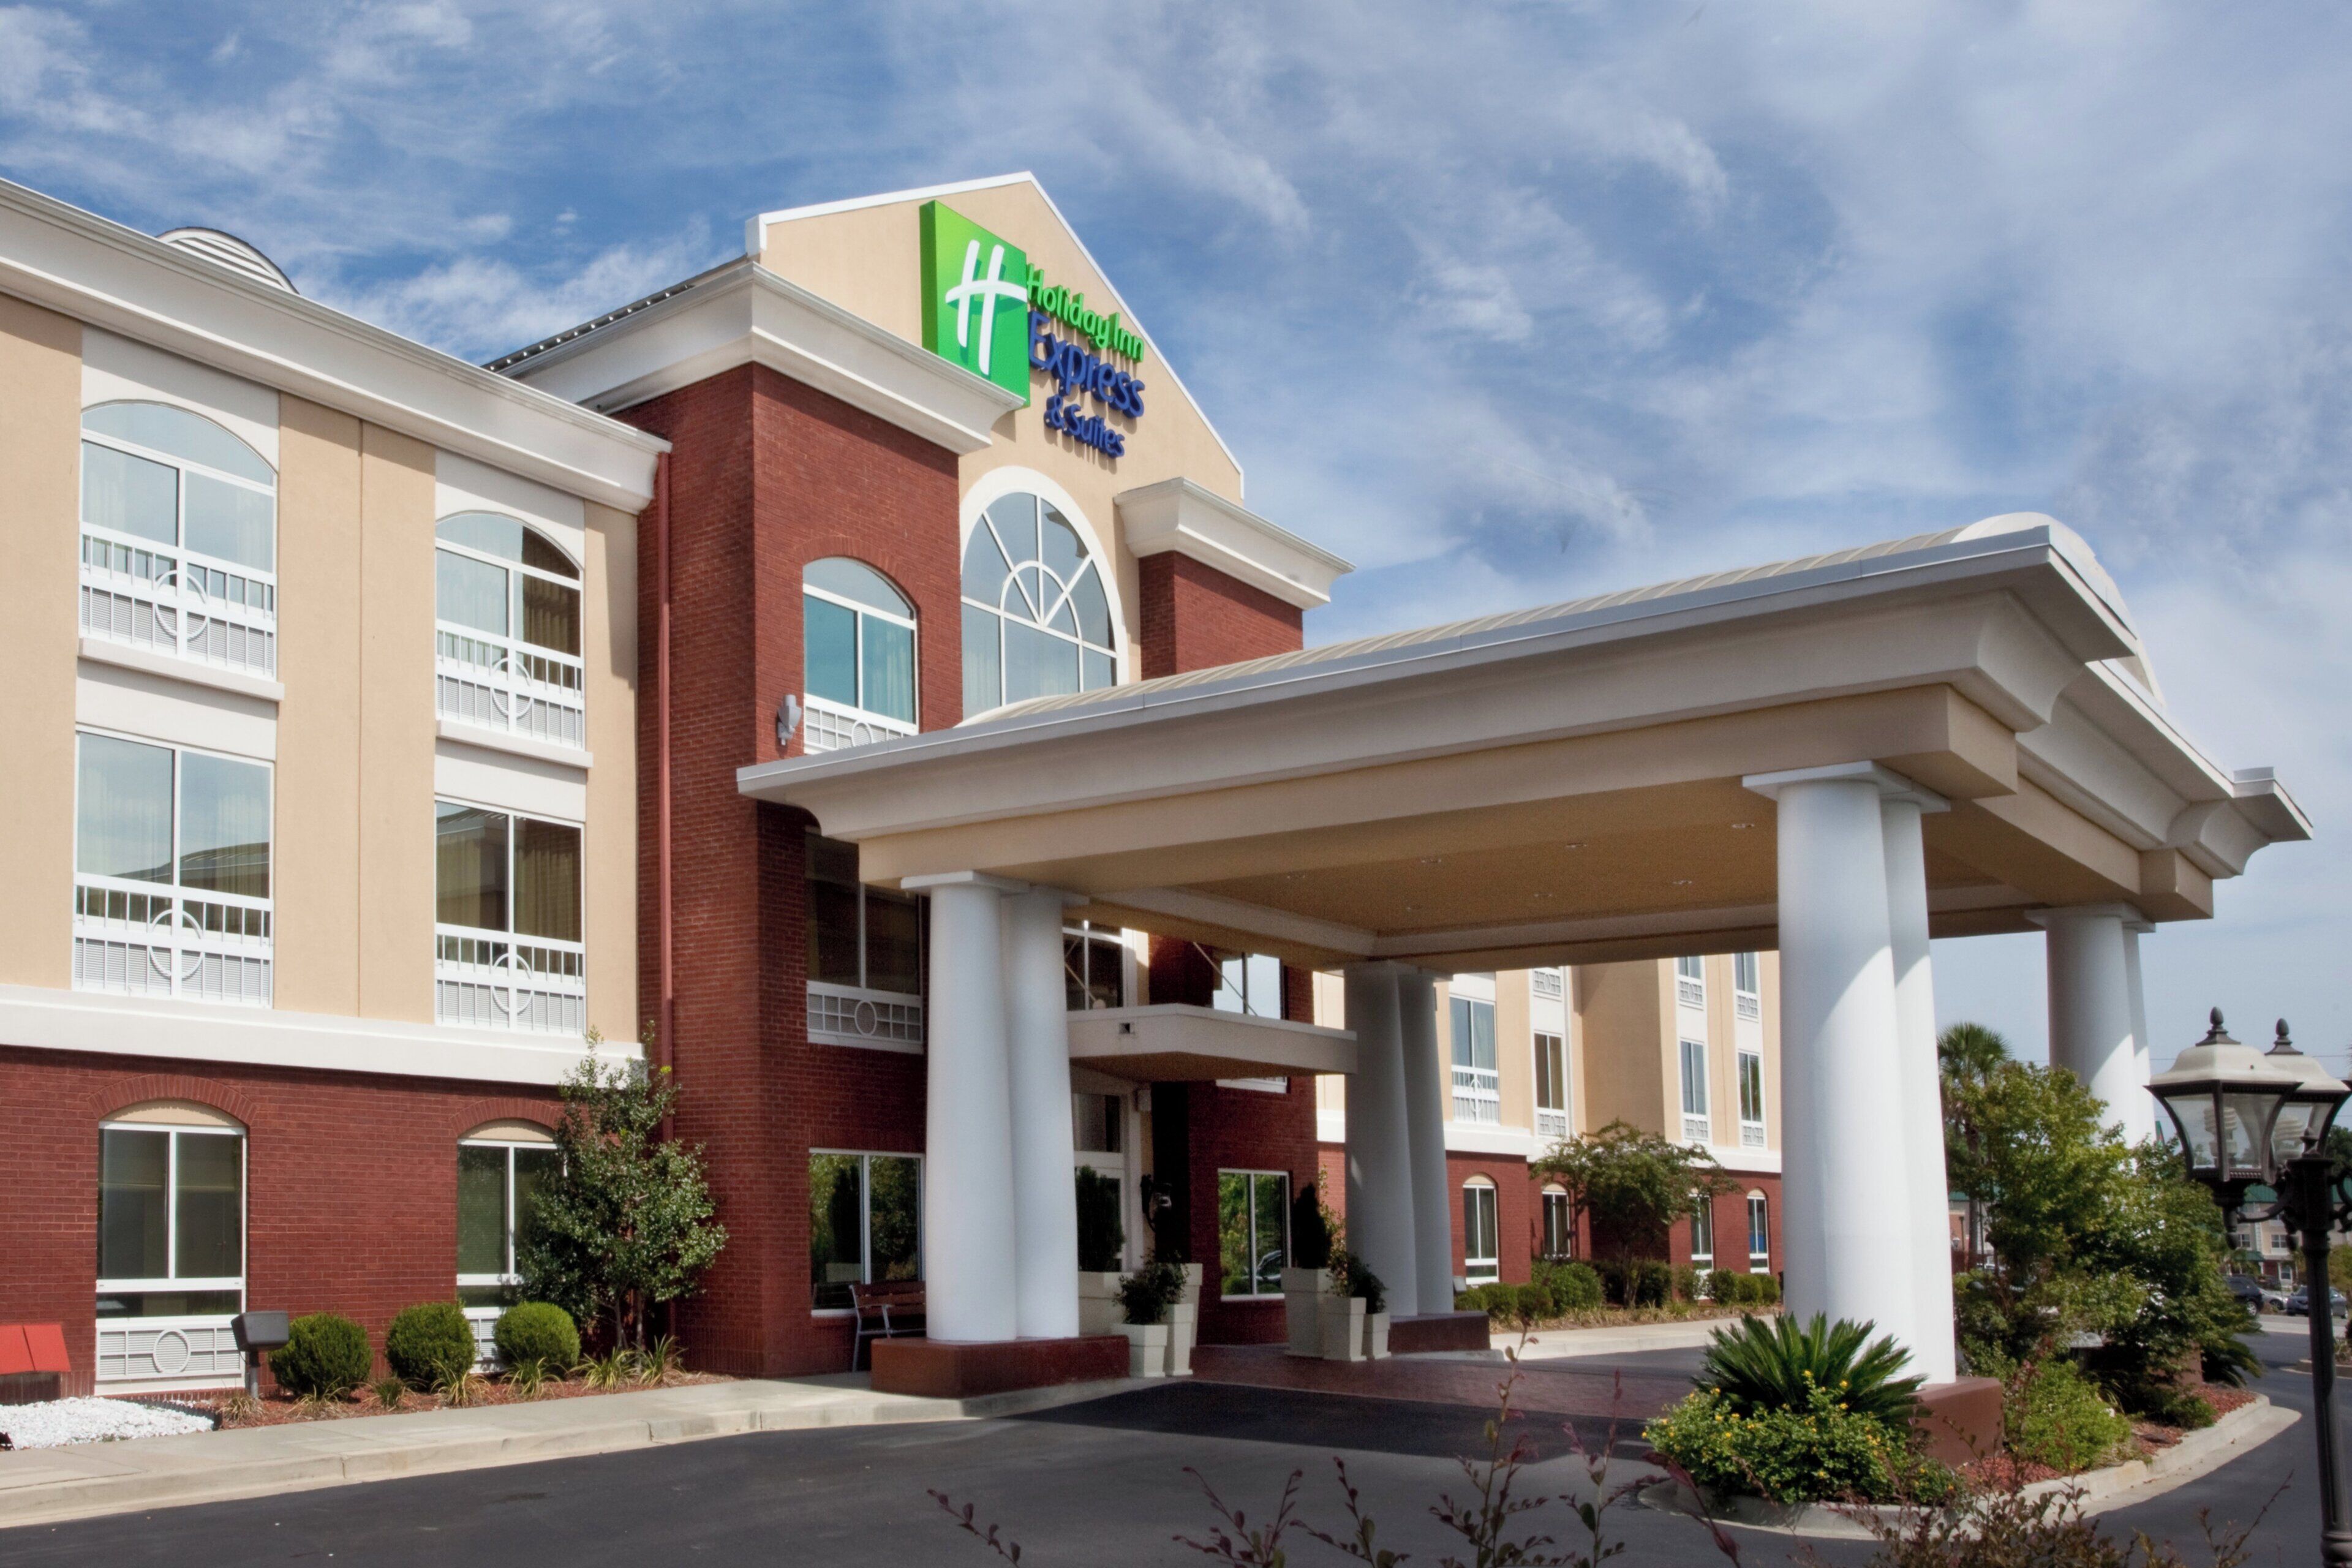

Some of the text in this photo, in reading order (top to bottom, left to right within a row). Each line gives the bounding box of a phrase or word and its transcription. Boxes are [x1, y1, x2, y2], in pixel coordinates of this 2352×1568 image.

[1027, 262, 1145, 363] Holiday Inn
[1028, 311, 1145, 418] Express
[1045, 394, 1125, 457] & Suites
